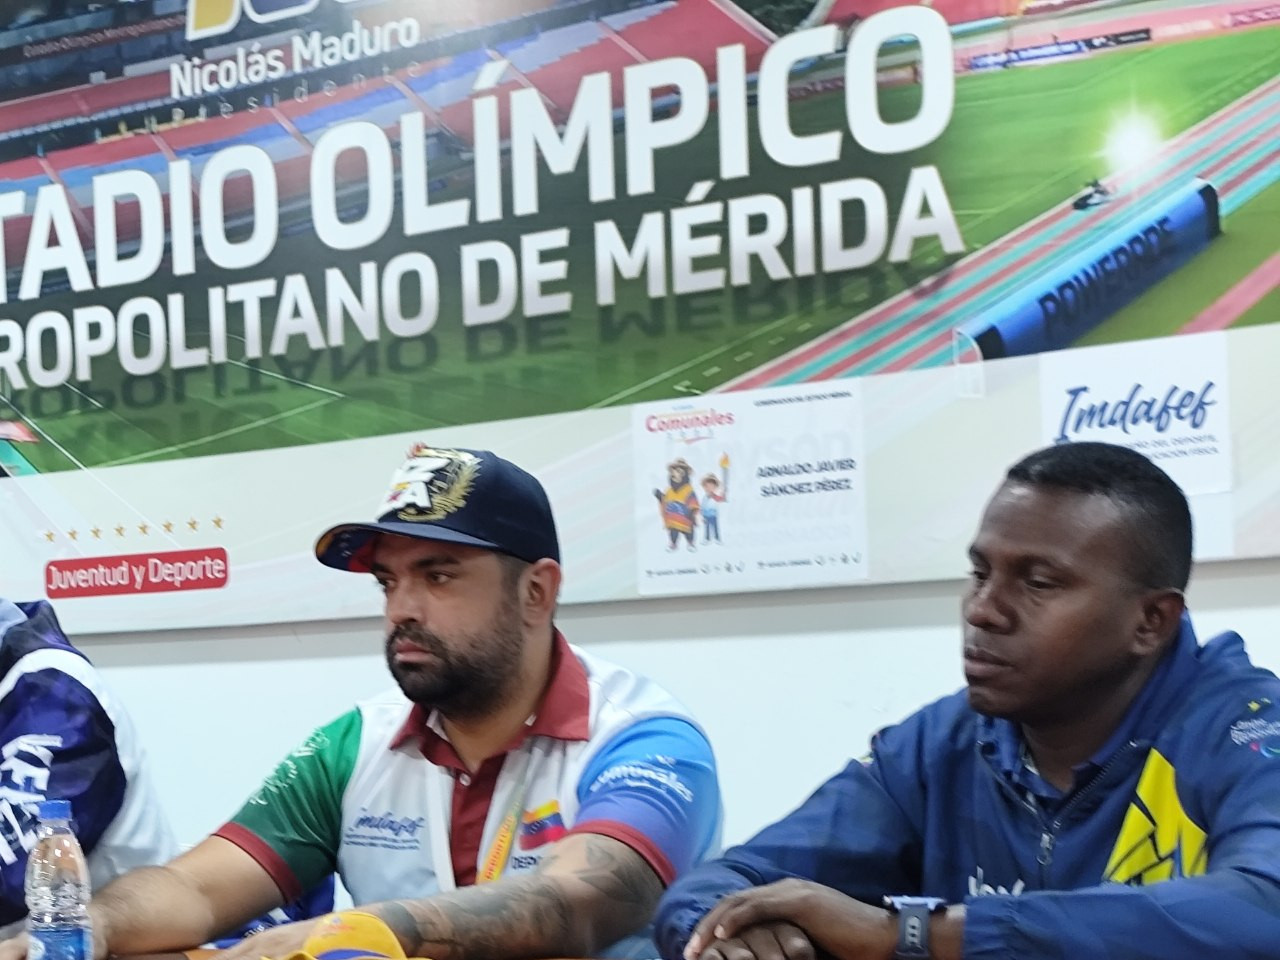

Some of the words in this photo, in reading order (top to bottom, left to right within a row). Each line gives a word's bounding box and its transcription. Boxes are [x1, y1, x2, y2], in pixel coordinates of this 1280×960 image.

[170, 41, 287, 99] Nicolás
[291, 16, 420, 74] Maduro
[309, 5, 956, 251] OLÍMPICO
[460, 227, 572, 327] DE
[593, 165, 965, 307] MÉRIDA
[645, 408, 735, 432] Comunales
[47, 560, 129, 590] Juventud
[132, 565, 145, 590] y
[148, 556, 225, 587] Deporte
